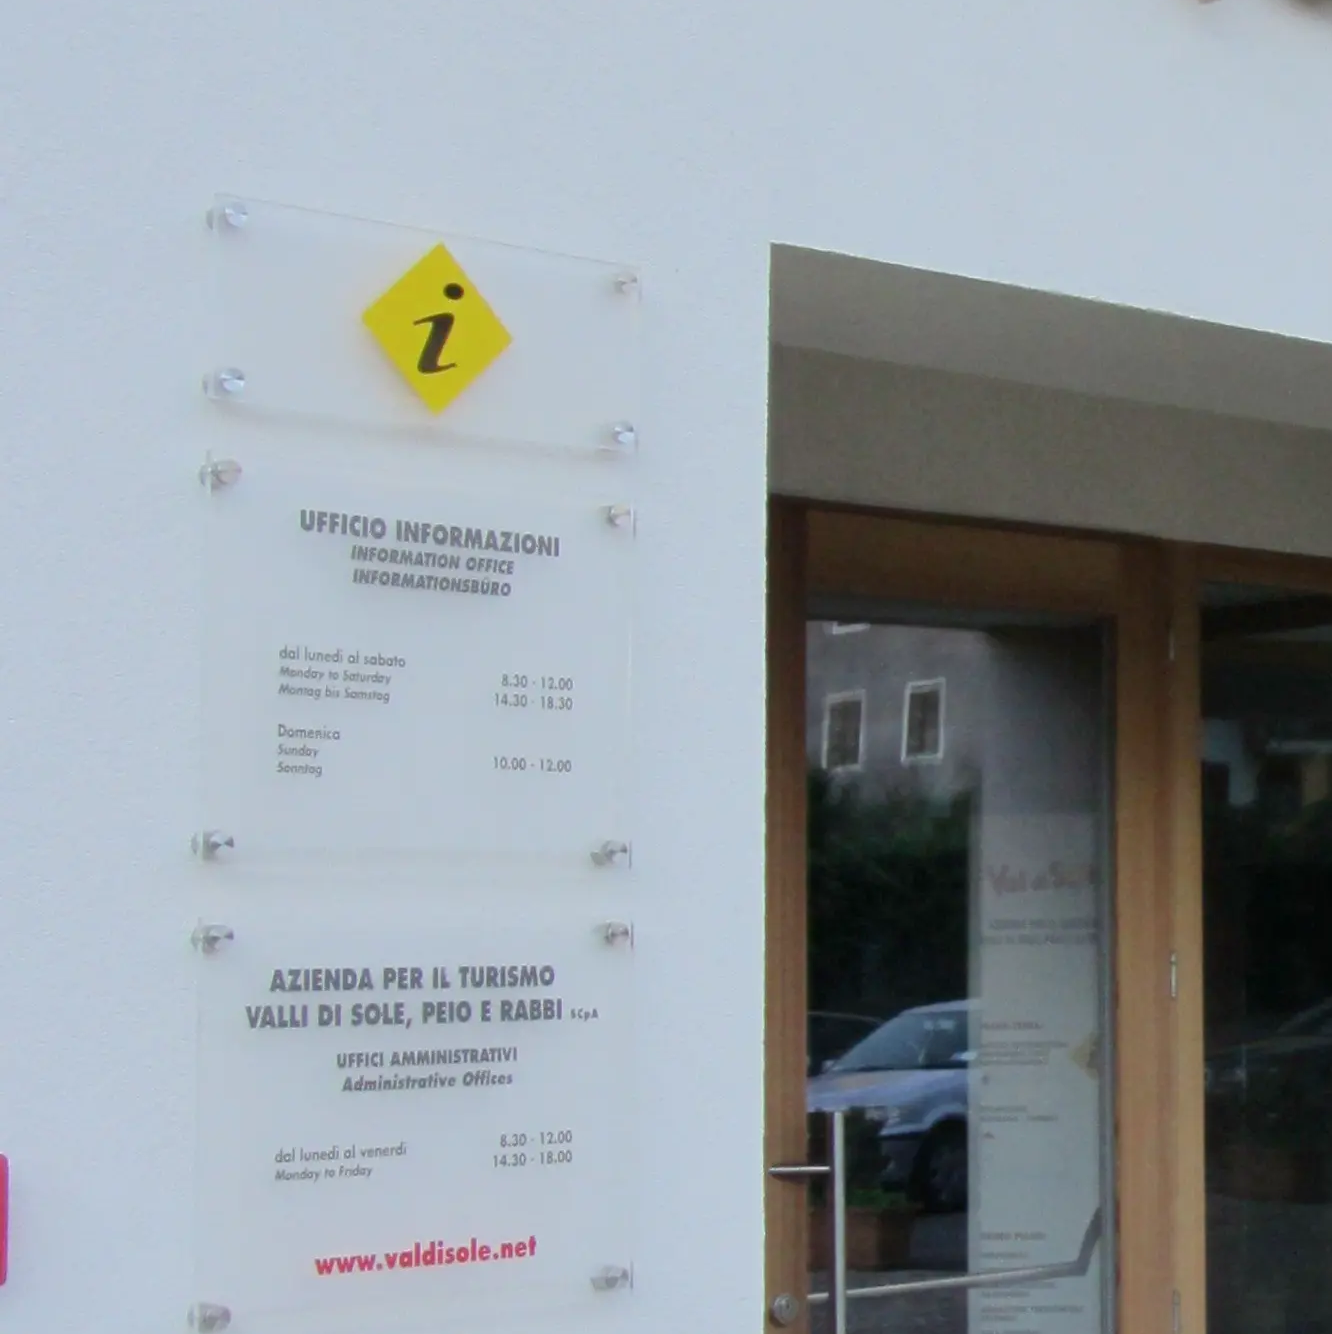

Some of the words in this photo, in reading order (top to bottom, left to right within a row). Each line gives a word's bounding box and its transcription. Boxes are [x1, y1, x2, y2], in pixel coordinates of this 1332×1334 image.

[300, 509, 386, 540] UFFICIO
[396, 519, 560, 557] INFORMAZIONI
[350, 544, 460, 570] INFORMATION
[466, 556, 514, 576] OFFICE
[352, 568, 512, 597] INFORMATIONSBÜRO
[279, 645, 300, 661] dal
[347, 651, 360, 665] al
[363, 653, 406, 668] sabato
[279, 666, 325, 681] Monday
[328, 670, 339, 681] to
[342, 670, 392, 685] Saturday
[501, 673, 528, 688] 8.30
[541, 676, 573, 691] 12.00
[278, 683, 322, 700] Montag
[325, 685, 340, 698] bis
[343, 688, 390, 705] Samstag
[495, 692, 528, 708] 14.30
[541, 695, 573, 711] 18.30
[278, 723, 341, 740] Domenica
[277, 744, 319, 759] Sunday
[276, 761, 323, 778] Sonntag
[493, 755, 527, 771] 10.00
[539, 757, 572, 773] 12.00
[269, 967, 374, 992] AZIENDA
[383, 966, 423, 990] PER
[432, 966, 450, 989] IL
[458, 965, 555, 989] TURISMO
[245, 1004, 308, 1029] VALLI
[318, 1004, 342, 1027] DI
[351, 1001, 412, 1030] SOLE,
[422, 1000, 472, 1024] PEIO
[480, 999, 492, 1022] E
[500, 998, 563, 1022] RABBI
[336, 1050, 384, 1069] UFFICI
[390, 1046, 518, 1067] AMMINISTRATIVI
[341, 1071, 456, 1092] Administrative
[462, 1069, 513, 1087] Offices
[500, 1132, 527, 1148] 8.30
[540, 1129, 573, 1145] 12.00
[275, 1147, 295, 1163] dal
[343, 1143, 356, 1159] al
[493, 1152, 527, 1168] 14.30
[540, 1149, 573, 1165] 18.00
[275, 1168, 320, 1184] Monday
[324, 1167, 336, 1179] to
[338, 1163, 373, 1178] Friday
[314, 1235, 537, 1275] www.valdisole.net
